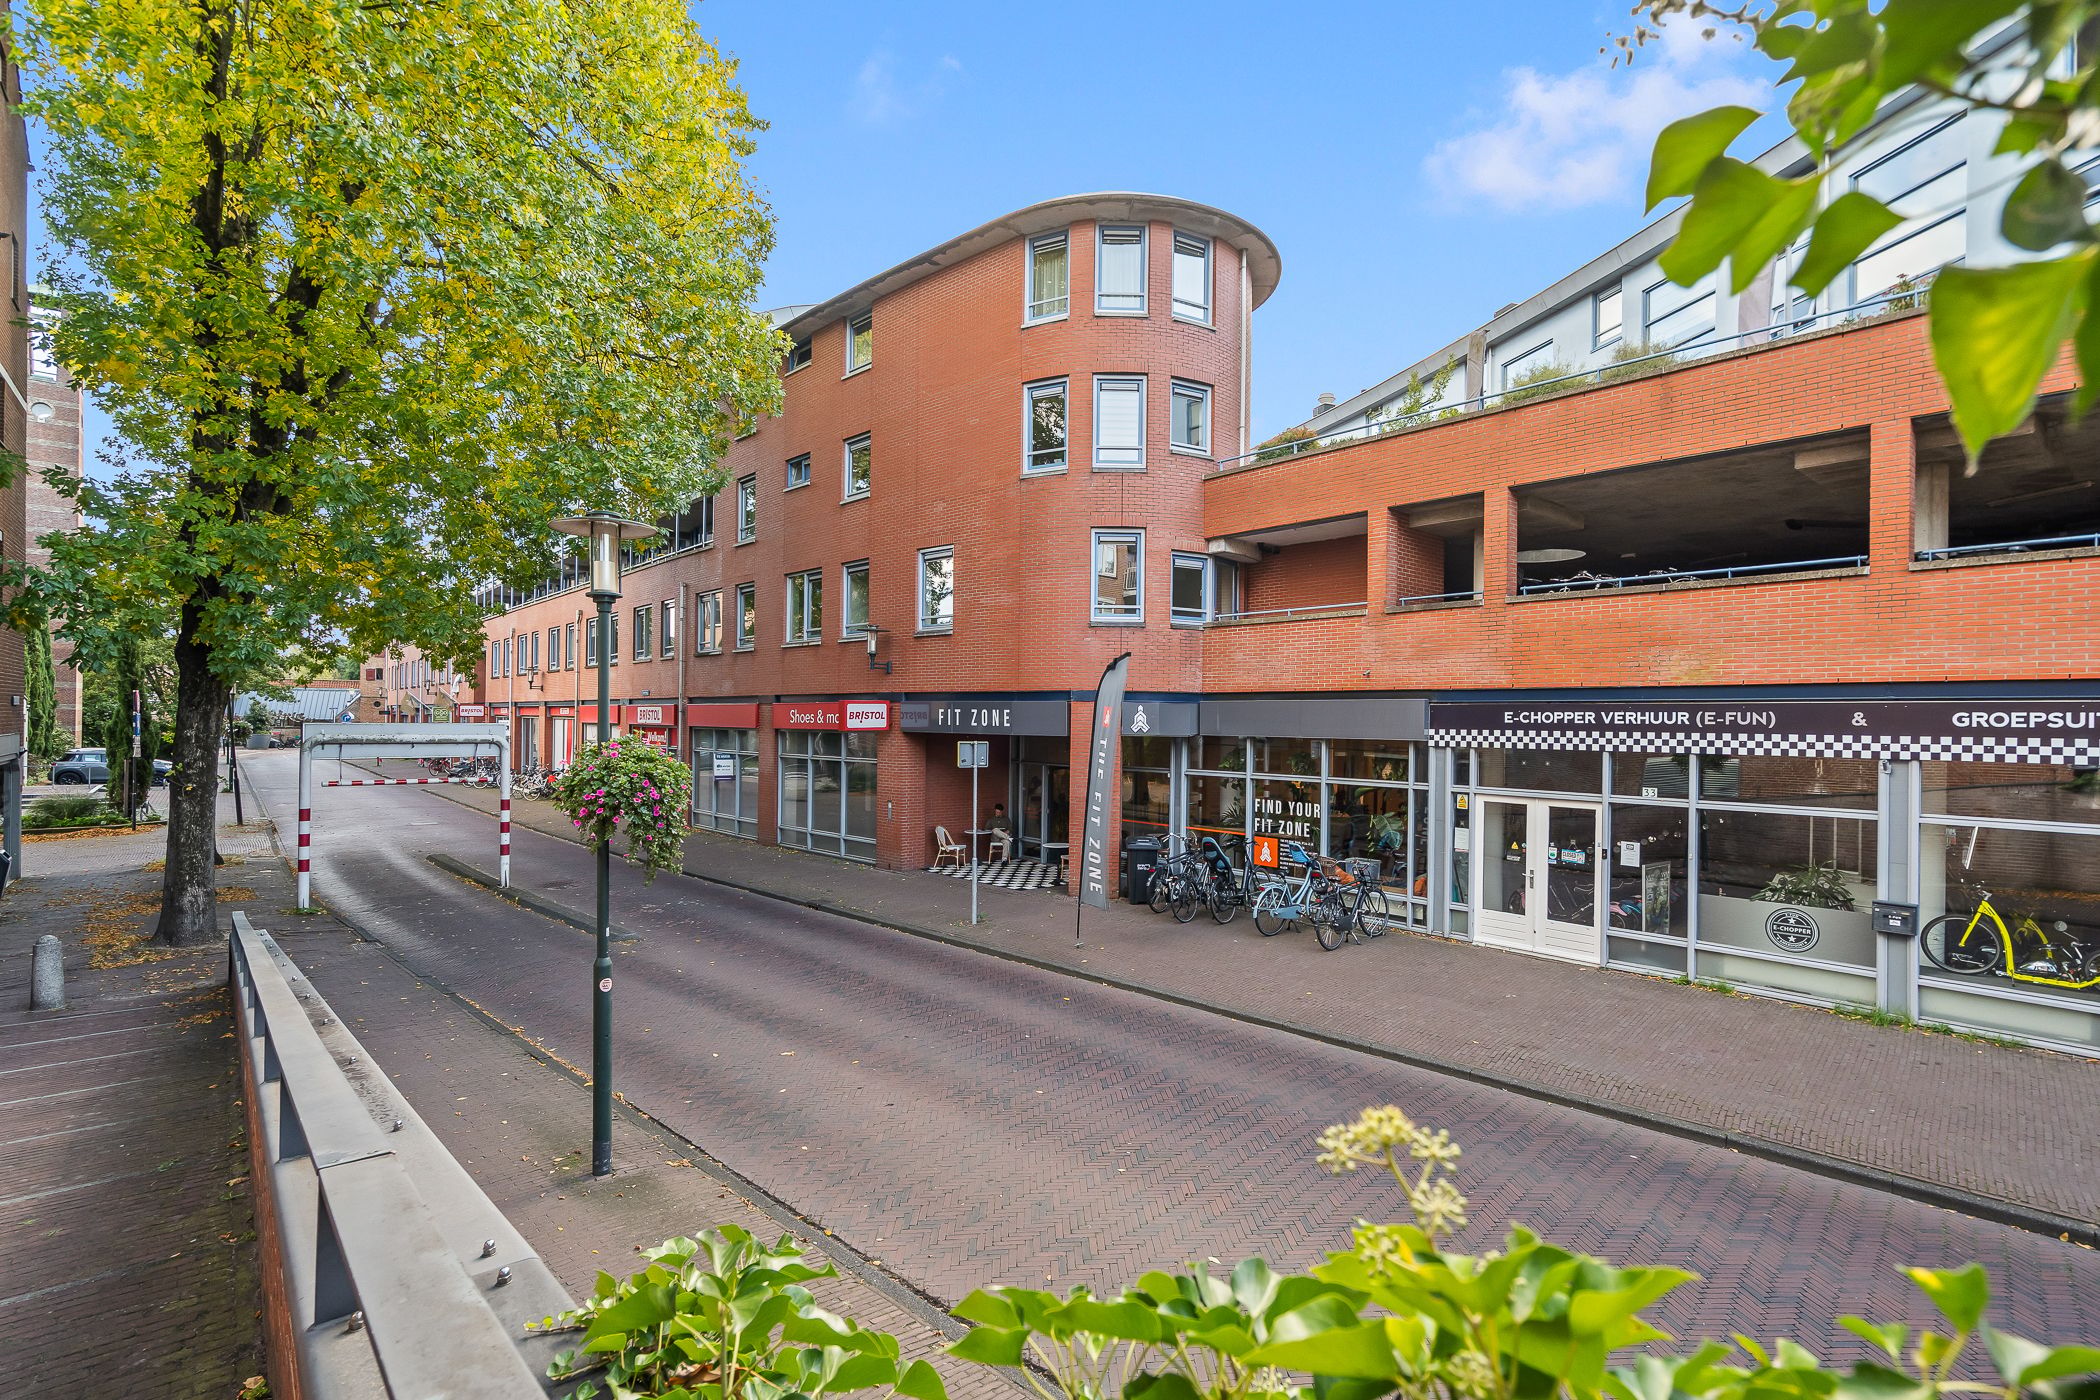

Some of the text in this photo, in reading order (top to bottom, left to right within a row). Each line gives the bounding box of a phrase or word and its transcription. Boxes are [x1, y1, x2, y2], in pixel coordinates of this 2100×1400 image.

[789, 709, 815, 724] Shoes
[816, 709, 824, 724] &
[938, 708, 1011, 727] FIT ZONE
[1504, 711, 2100, 729] E-CHOPPER VERHUUR (E-FUN) & GROEPSUI
[1643, 788, 1656, 797] 33
[1089, 738, 1108, 895] THE FIT ZONE
[1254, 798, 1321, 818] FIND YOUR
[1254, 817, 1311, 838] FIT ZONE
[1773, 924, 1812, 936] E-CHOPPER
